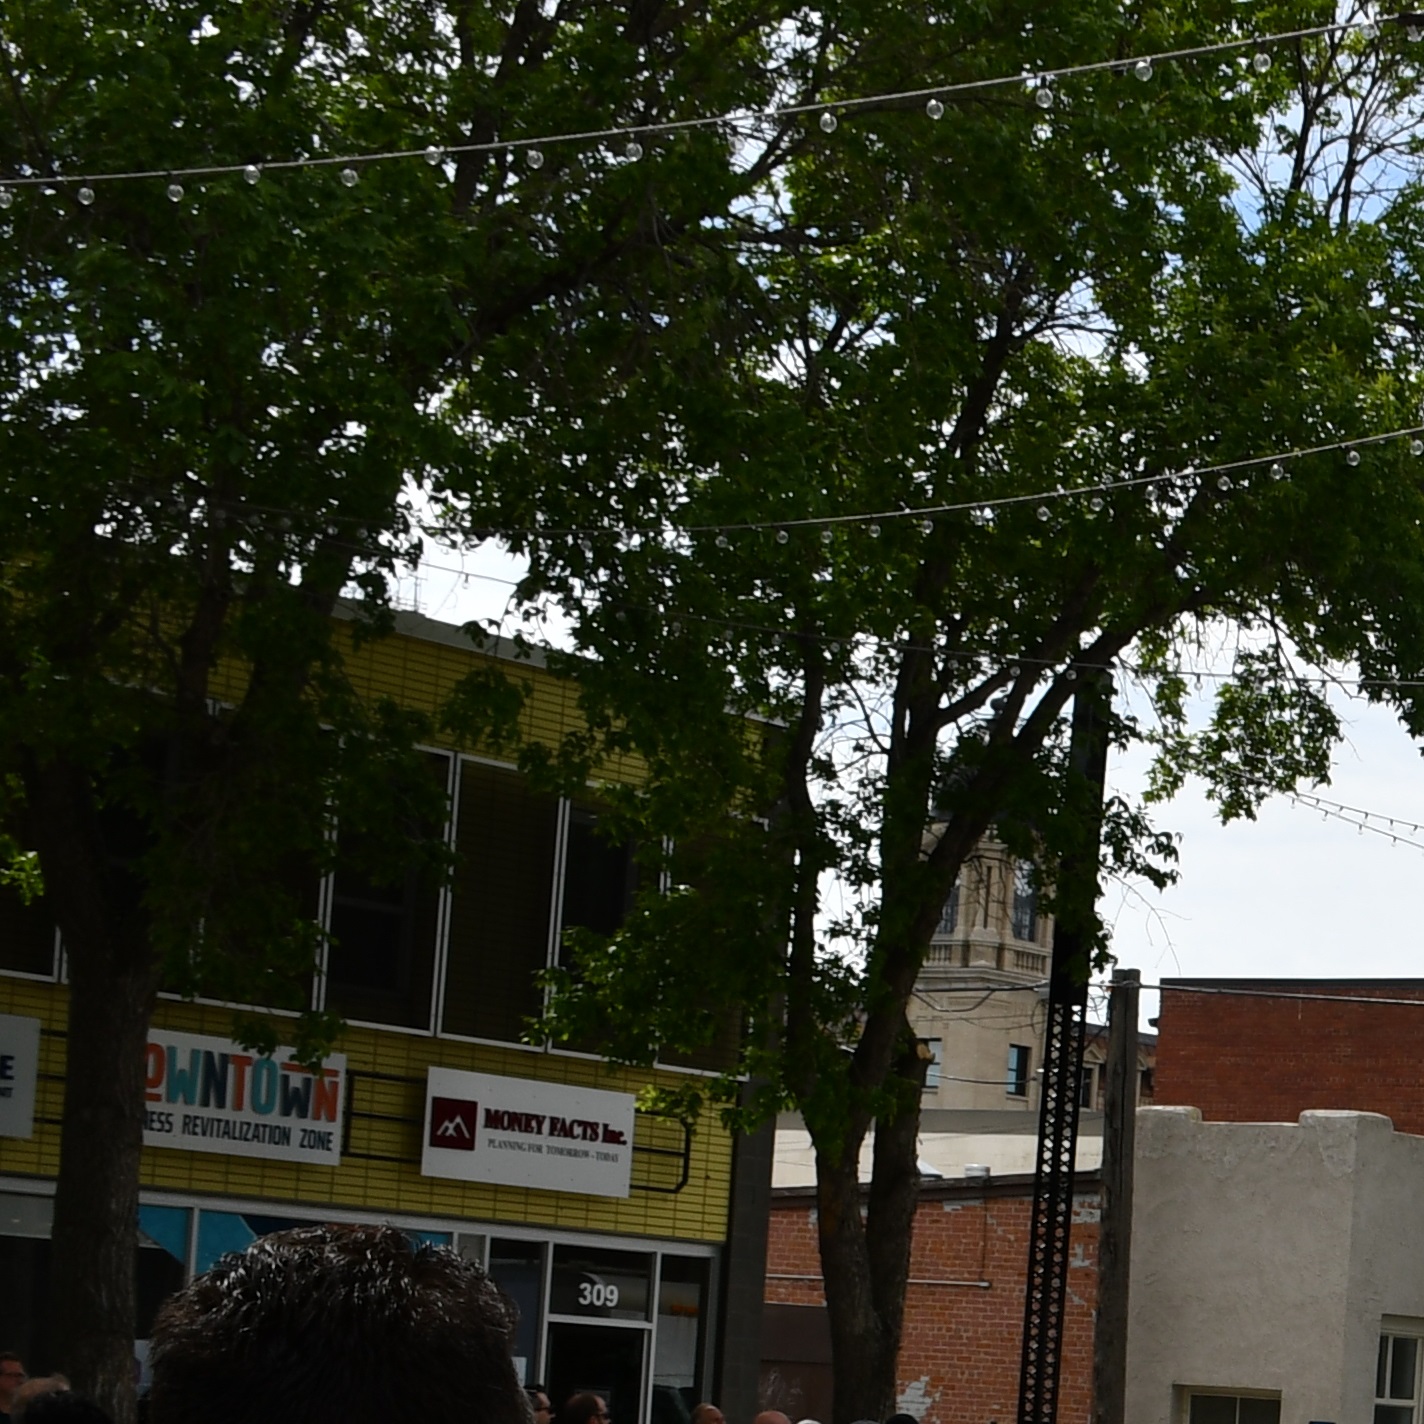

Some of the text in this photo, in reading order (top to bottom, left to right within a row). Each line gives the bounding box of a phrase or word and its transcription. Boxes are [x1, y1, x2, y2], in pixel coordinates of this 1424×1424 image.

[145, 1043, 340, 1123] OWNTOWN
[182, 1114, 292, 1147] REVITALIZATION
[299, 1128, 334, 1152] ZONE
[484, 1107, 628, 1146] MONEY FACTS Inc.
[487, 1138, 527, 1152] PLANNING
[528, 1143, 543, 1154] FOR
[546, 1144, 590, 1160] TOMORROW
[596, 1151, 620, 1163] TODAY
[577, 1281, 620, 1309] 309
